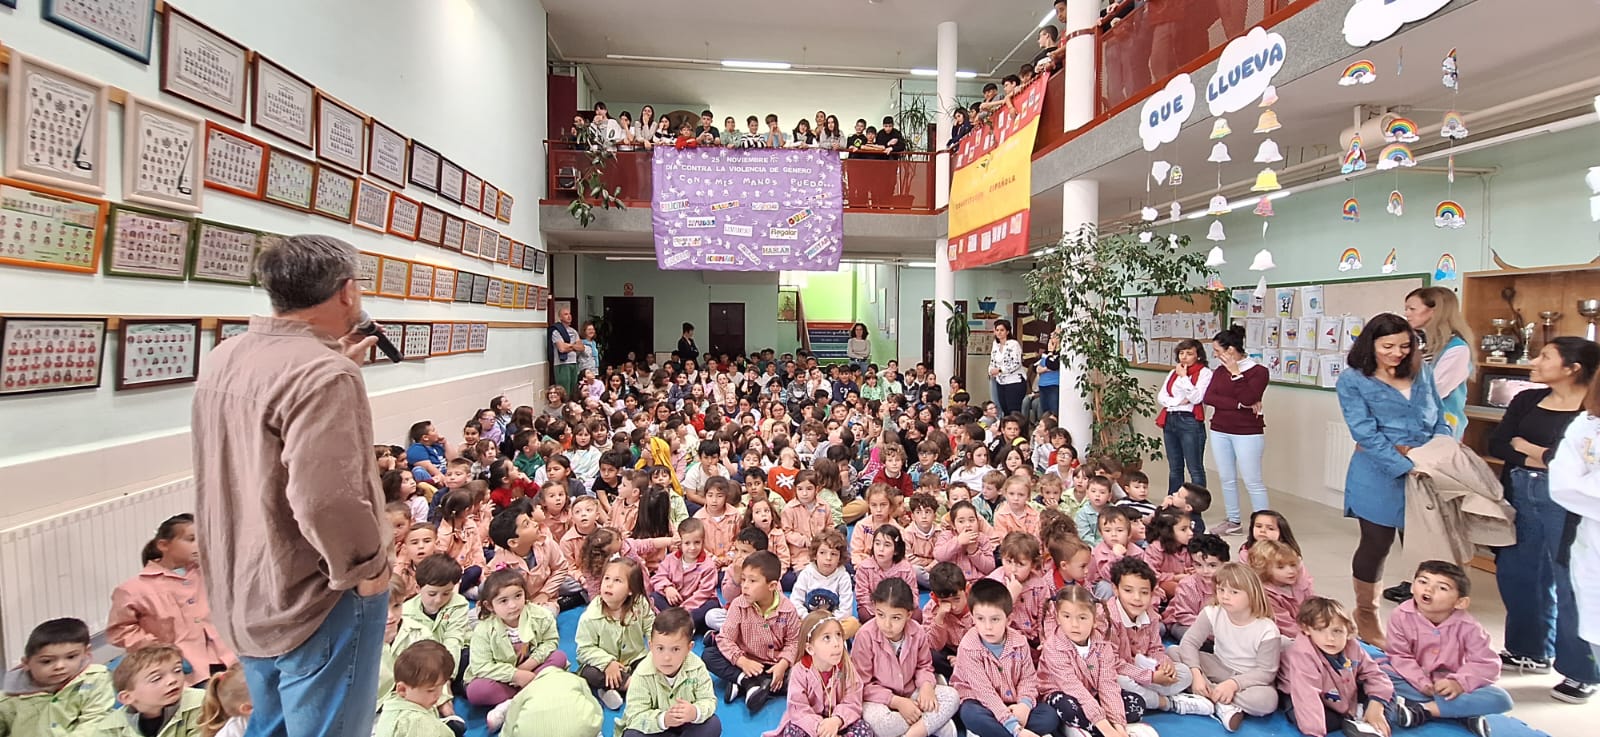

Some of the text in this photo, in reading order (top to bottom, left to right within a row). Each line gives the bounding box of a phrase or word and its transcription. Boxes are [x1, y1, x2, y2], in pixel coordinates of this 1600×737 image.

[1208, 43, 1283, 102] LLUEVA
[1149, 94, 1184, 128] QUE
[681, 164, 712, 172] CONTRA
[728, 165, 767, 173] VIOLENCIA
[679, 174, 700, 184] CON
[715, 178, 734, 187] MIS
[743, 177, 778, 186] MANOS
[770, 228, 797, 237] Regalar
